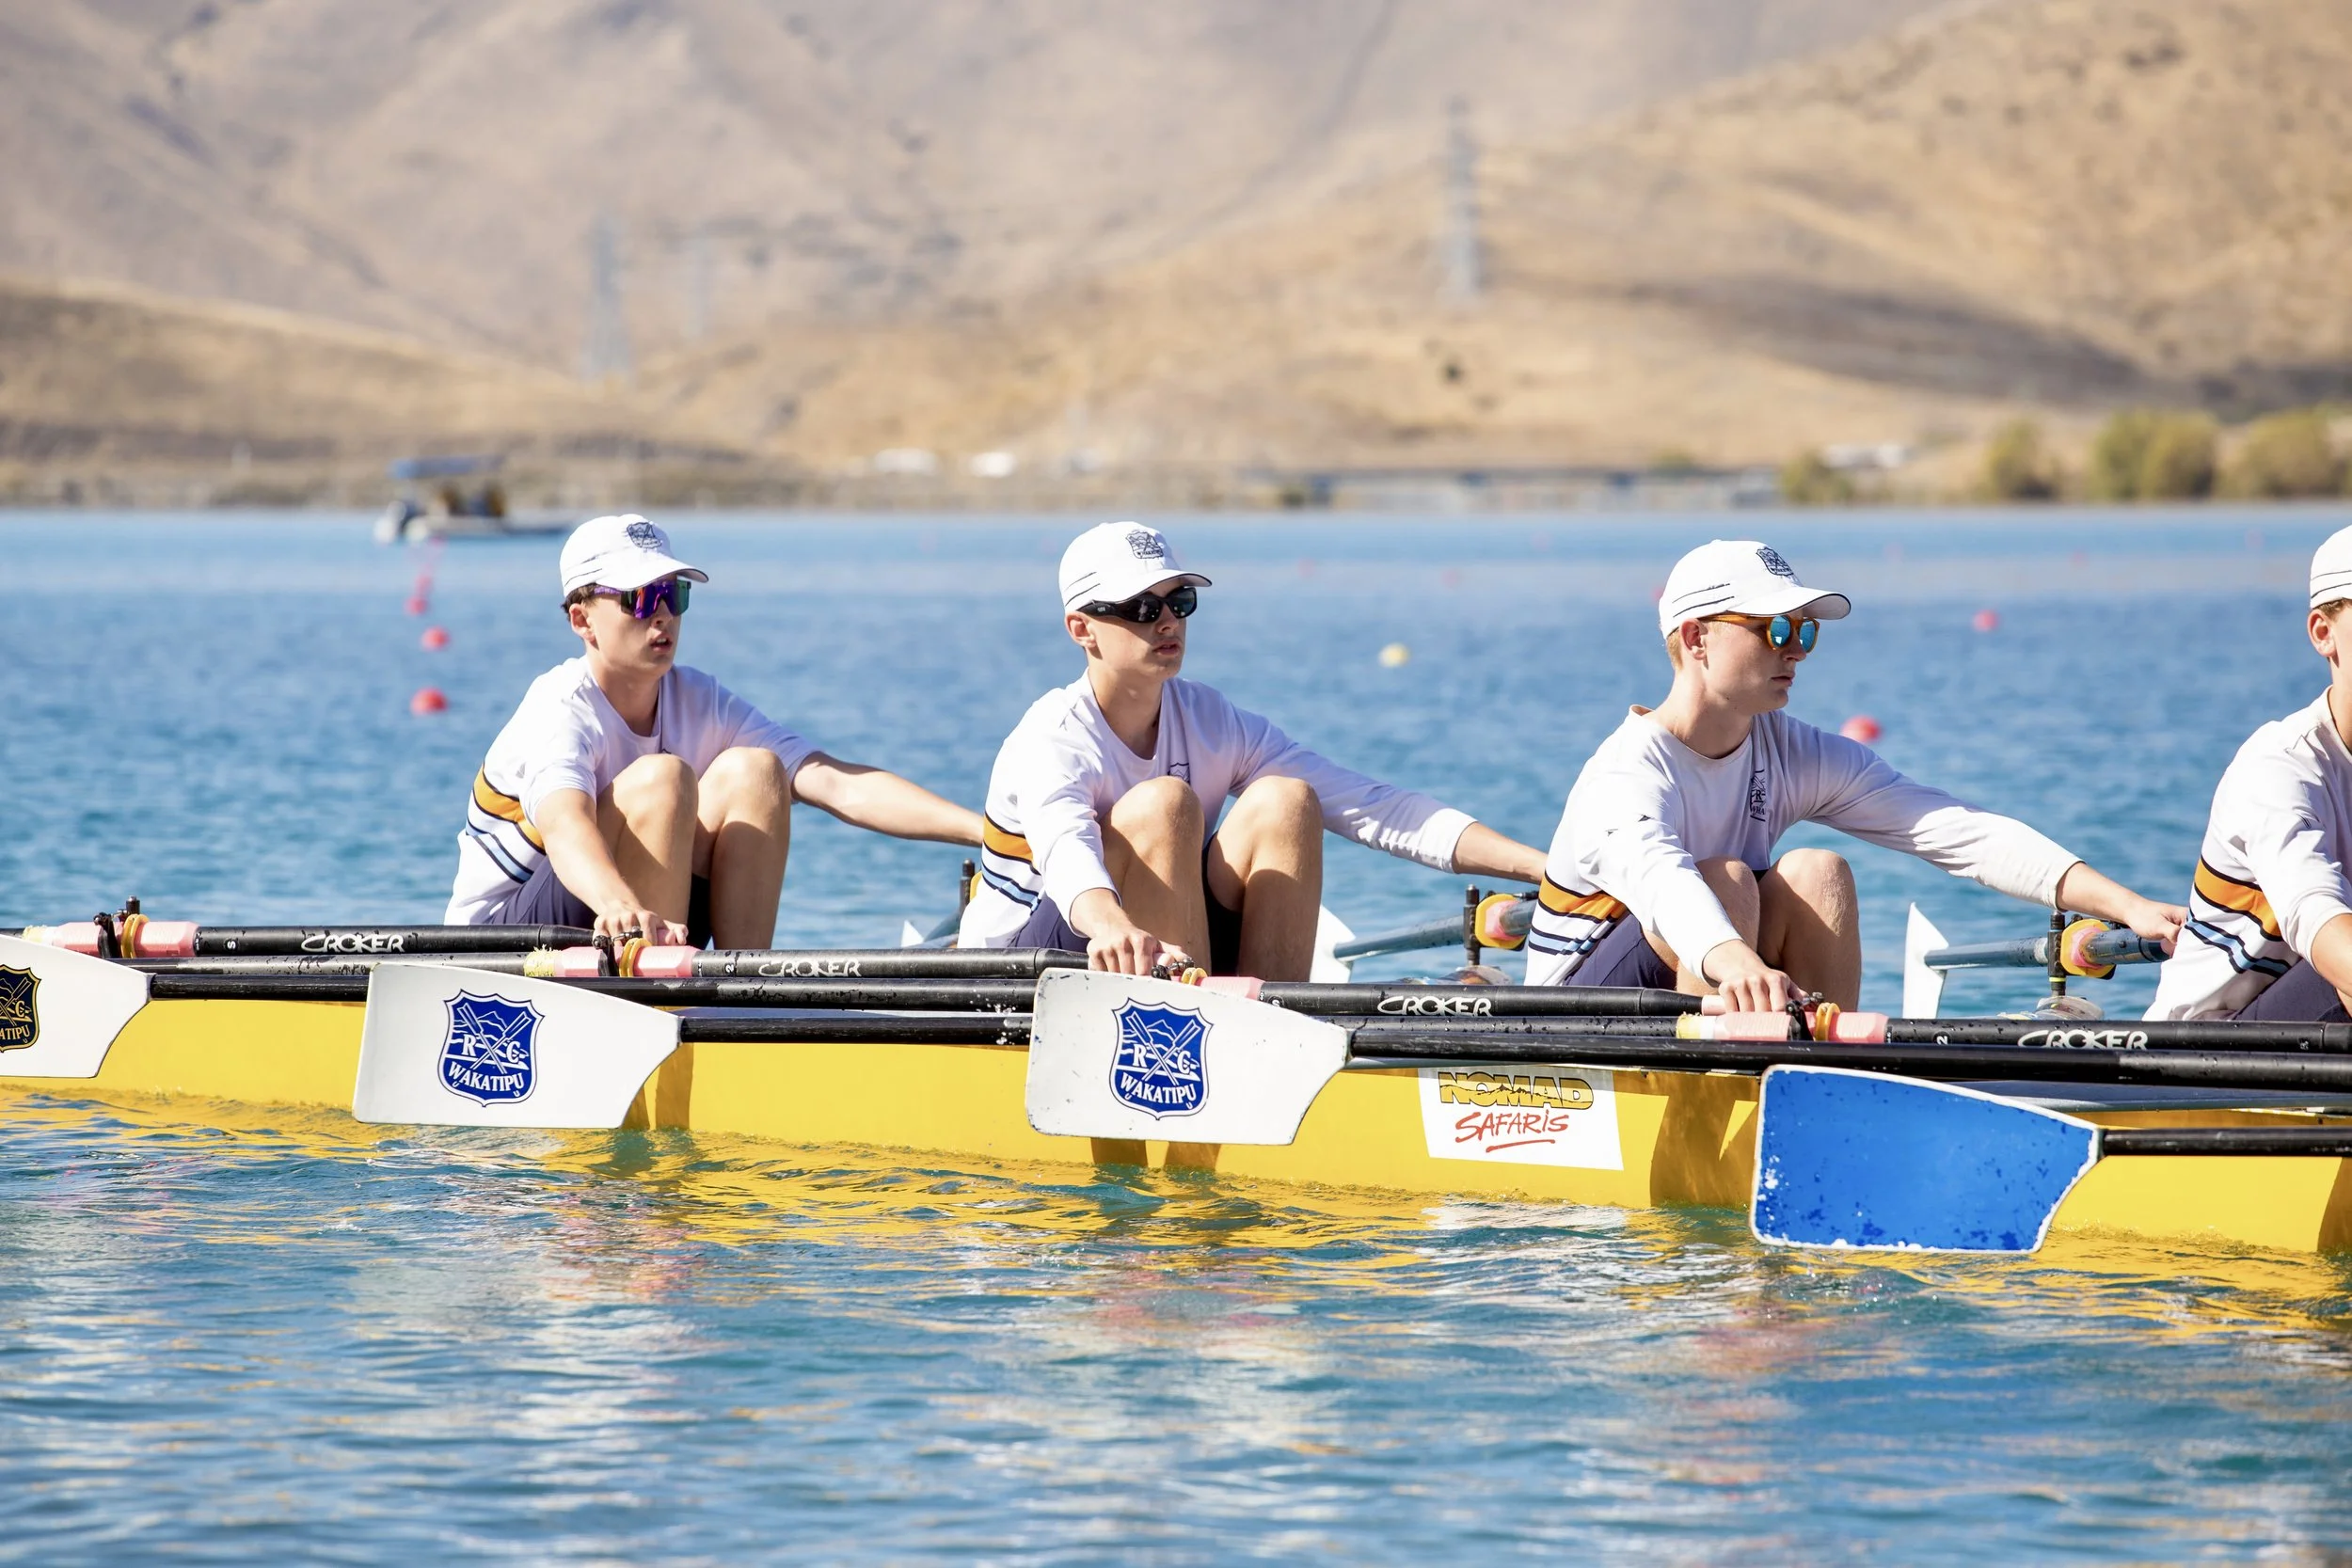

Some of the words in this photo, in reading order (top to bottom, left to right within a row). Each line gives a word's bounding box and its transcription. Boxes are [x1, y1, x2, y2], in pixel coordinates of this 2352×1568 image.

[300, 933, 405, 953] CROKER
[724, 964, 735, 974] 2
[758, 958, 862, 977] CROKER
[1377, 995, 1493, 1017] CROKER
[0, 1024, 30, 1040] ATIPU
[2017, 1029, 2149, 1051] CROKER
[461, 1034, 477, 1056] R
[1132, 1043, 1148, 1068] R
[448, 1061, 525, 1092] WAKATIPU
[1120, 1071, 1197, 1103] WAKATIPU
[1438, 1071, 1595, 1110] NOMAD
